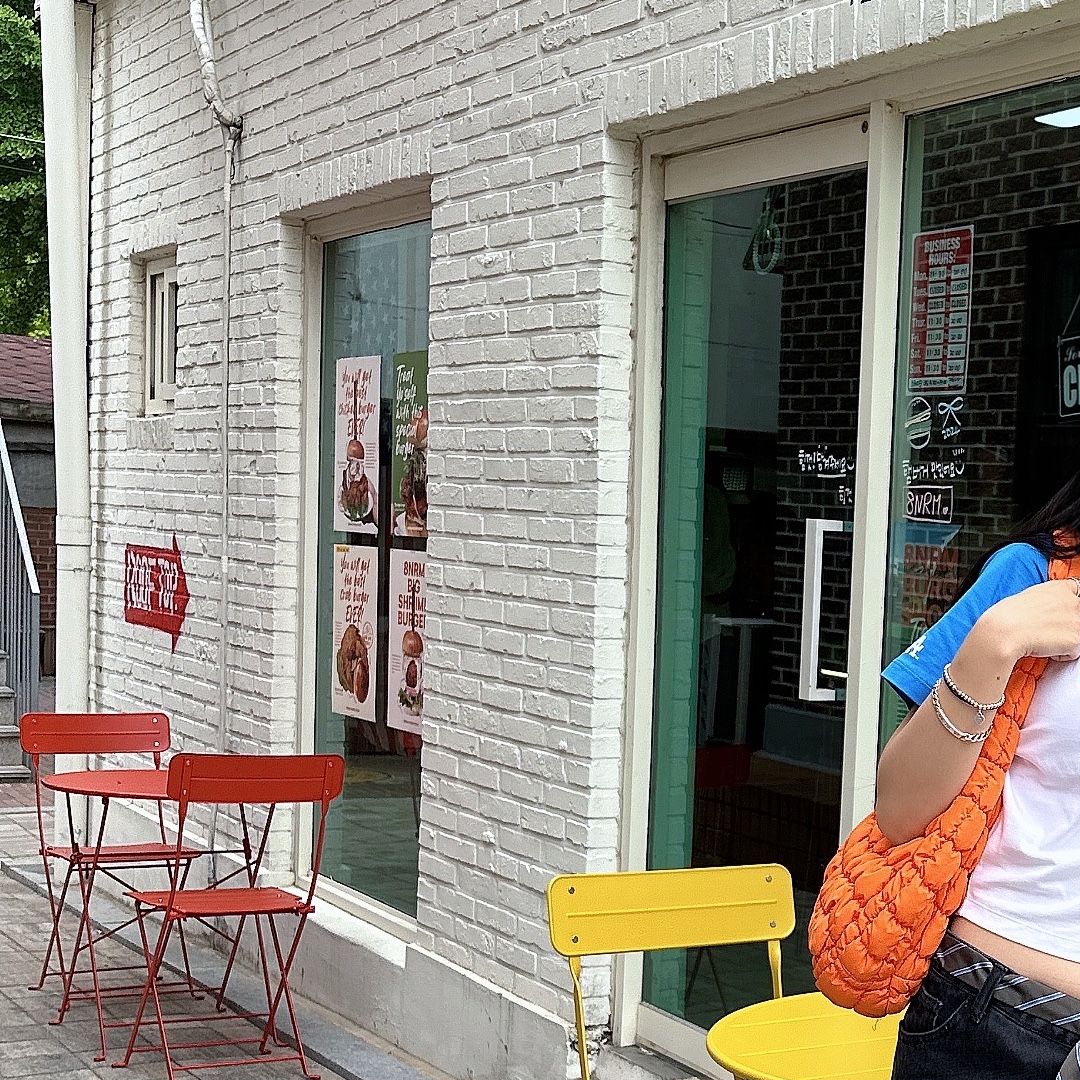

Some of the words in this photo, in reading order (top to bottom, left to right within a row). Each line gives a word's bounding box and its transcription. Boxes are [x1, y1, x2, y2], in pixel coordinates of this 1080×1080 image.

[924, 236, 961, 253] BUSINESS
[928, 251, 956, 266] HOURS:
[396, 364, 415, 386] Treat
[906, 491, 942, 516] 8NRM
[407, 578, 421, 594] BIG
